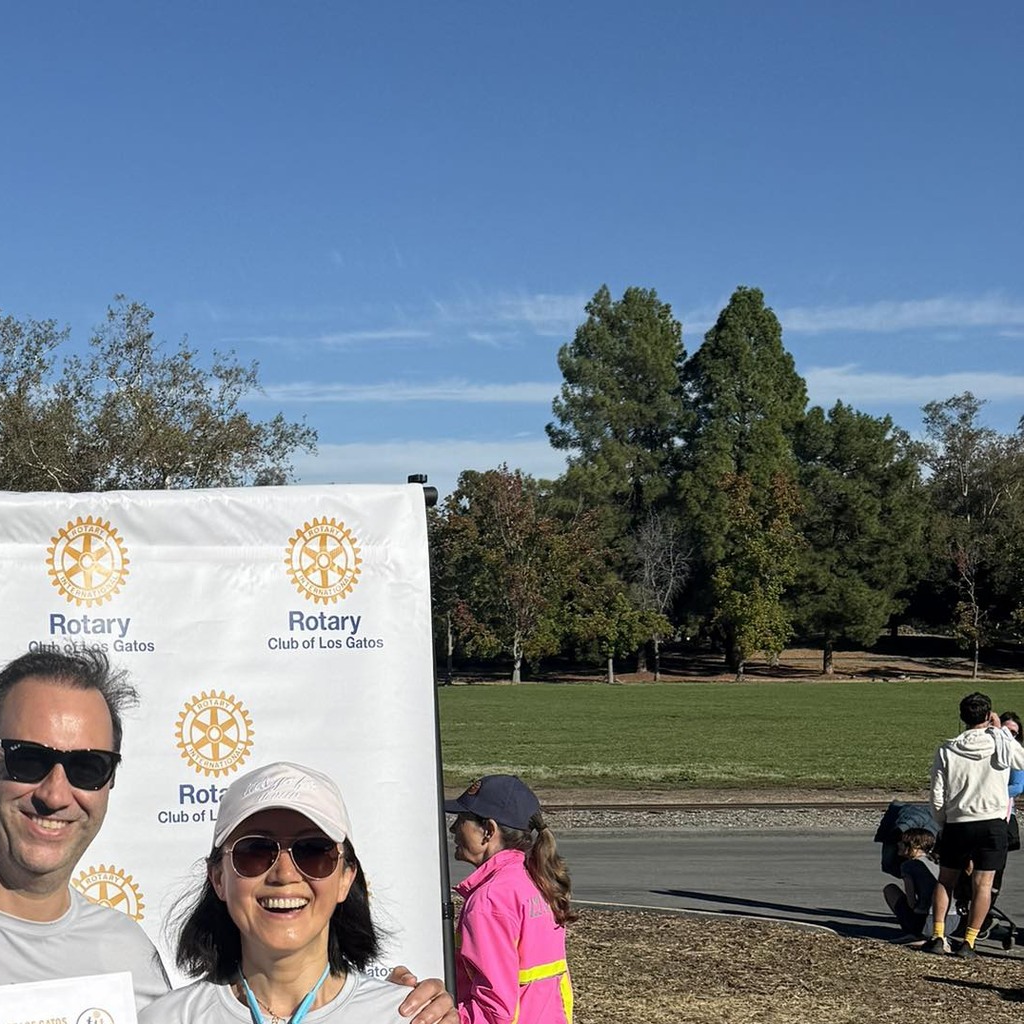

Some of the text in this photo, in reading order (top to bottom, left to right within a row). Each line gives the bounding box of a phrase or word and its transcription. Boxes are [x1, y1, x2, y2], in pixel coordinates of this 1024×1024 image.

[70, 525, 105, 536] ROTARY
[308, 526, 339, 536] ROTARY
[59, 575, 118, 598] INTERNATIONAL
[298, 574, 352, 596] INTERNATIONAL
[49, 613, 131, 638] Rotary
[288, 611, 361, 635] Rotary
[113, 640, 155, 652] Gatos
[268, 636, 384, 650] Club of Los Gatos
[197, 700, 230, 710] ROTARY
[189, 746, 244, 768] INTERNATIONAL
[158, 811, 189, 823] Club
[193, 810, 205, 822] of
[86, 874, 120, 884] ROTARY
